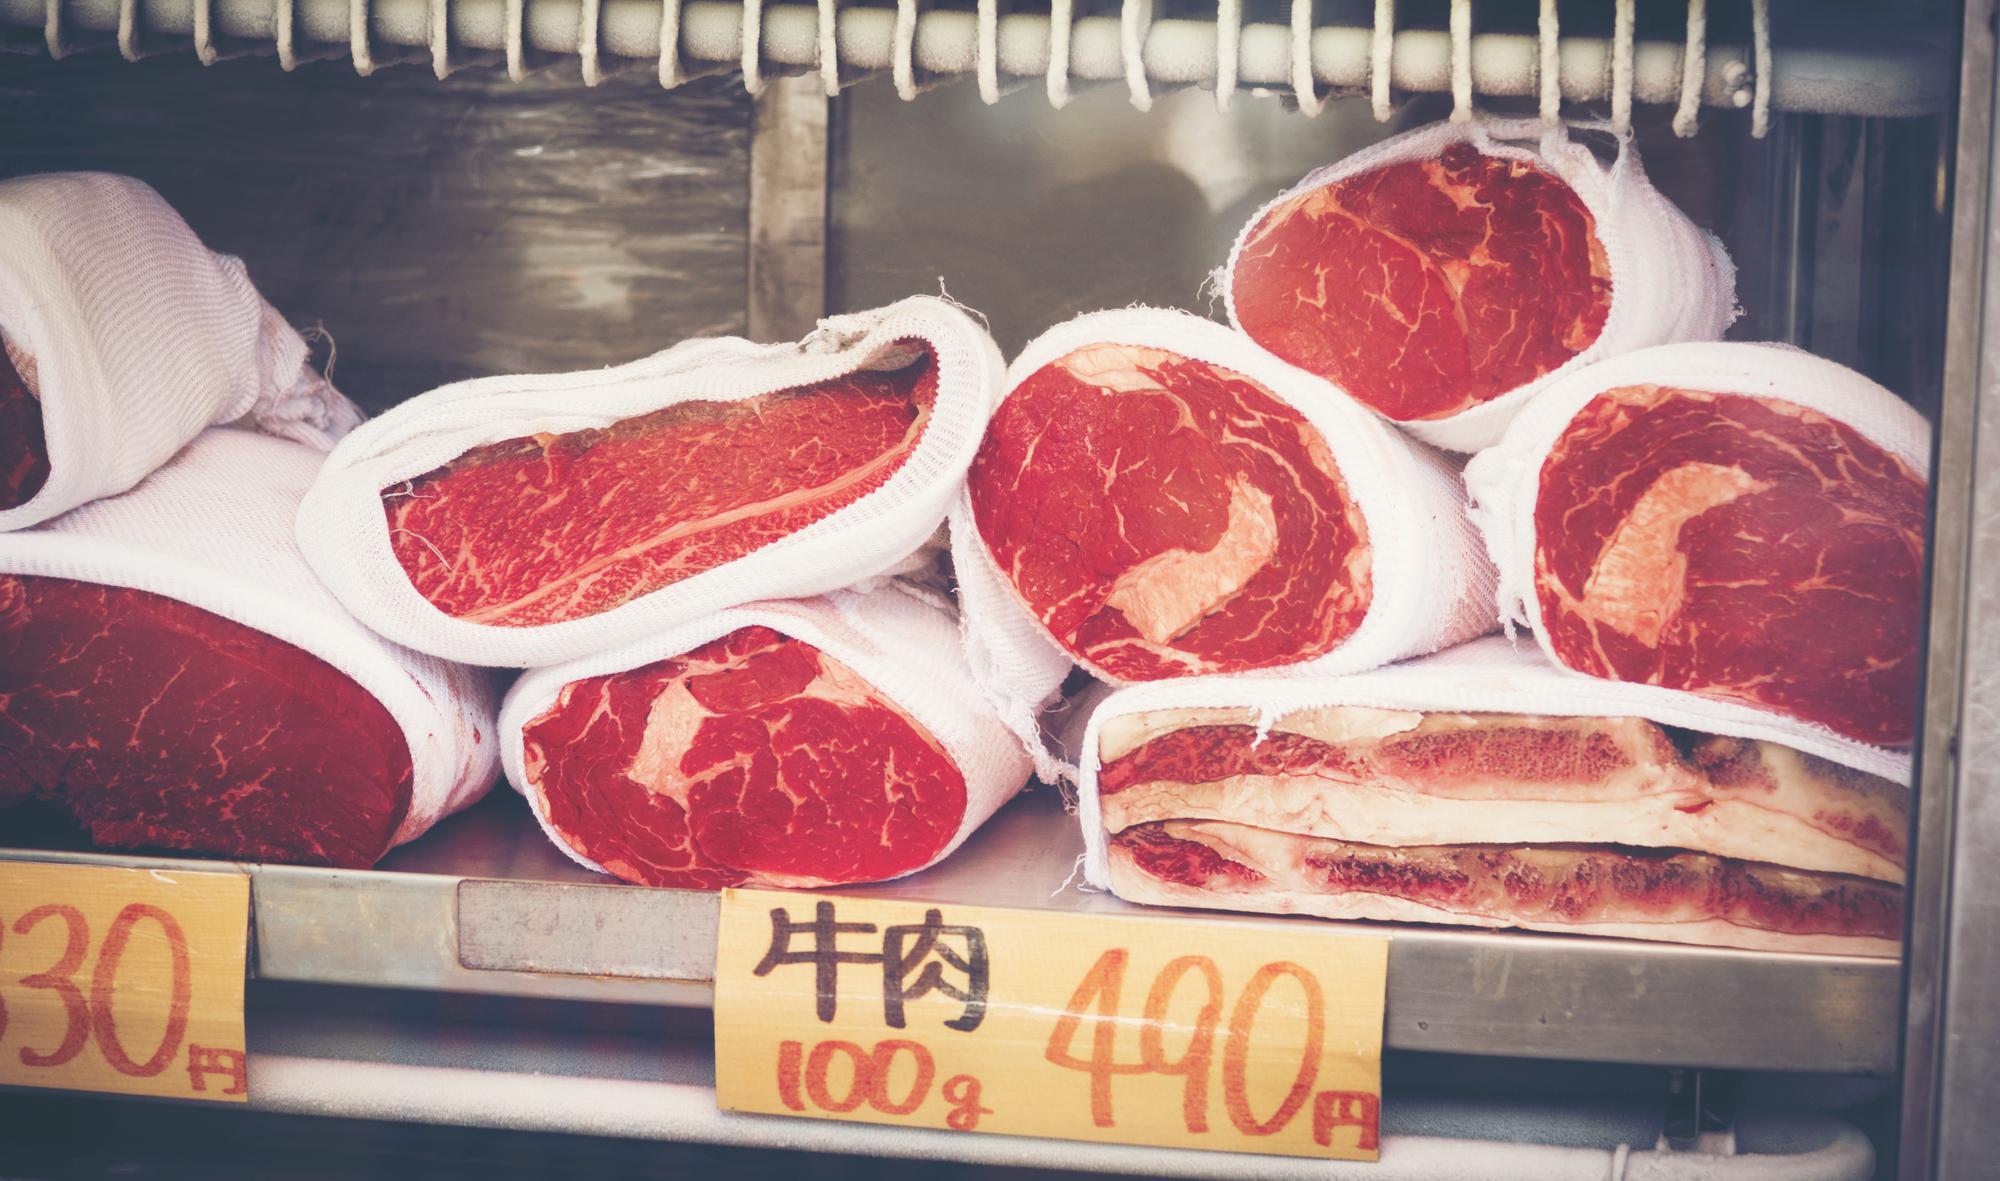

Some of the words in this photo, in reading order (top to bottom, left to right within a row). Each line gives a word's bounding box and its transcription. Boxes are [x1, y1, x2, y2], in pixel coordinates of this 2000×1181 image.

[0, 903, 247, 1094] 30円
[753, 901, 989, 1031] 牛肉
[777, 1039, 994, 1131] 100g
[1044, 948, 1379, 1150] 490円
